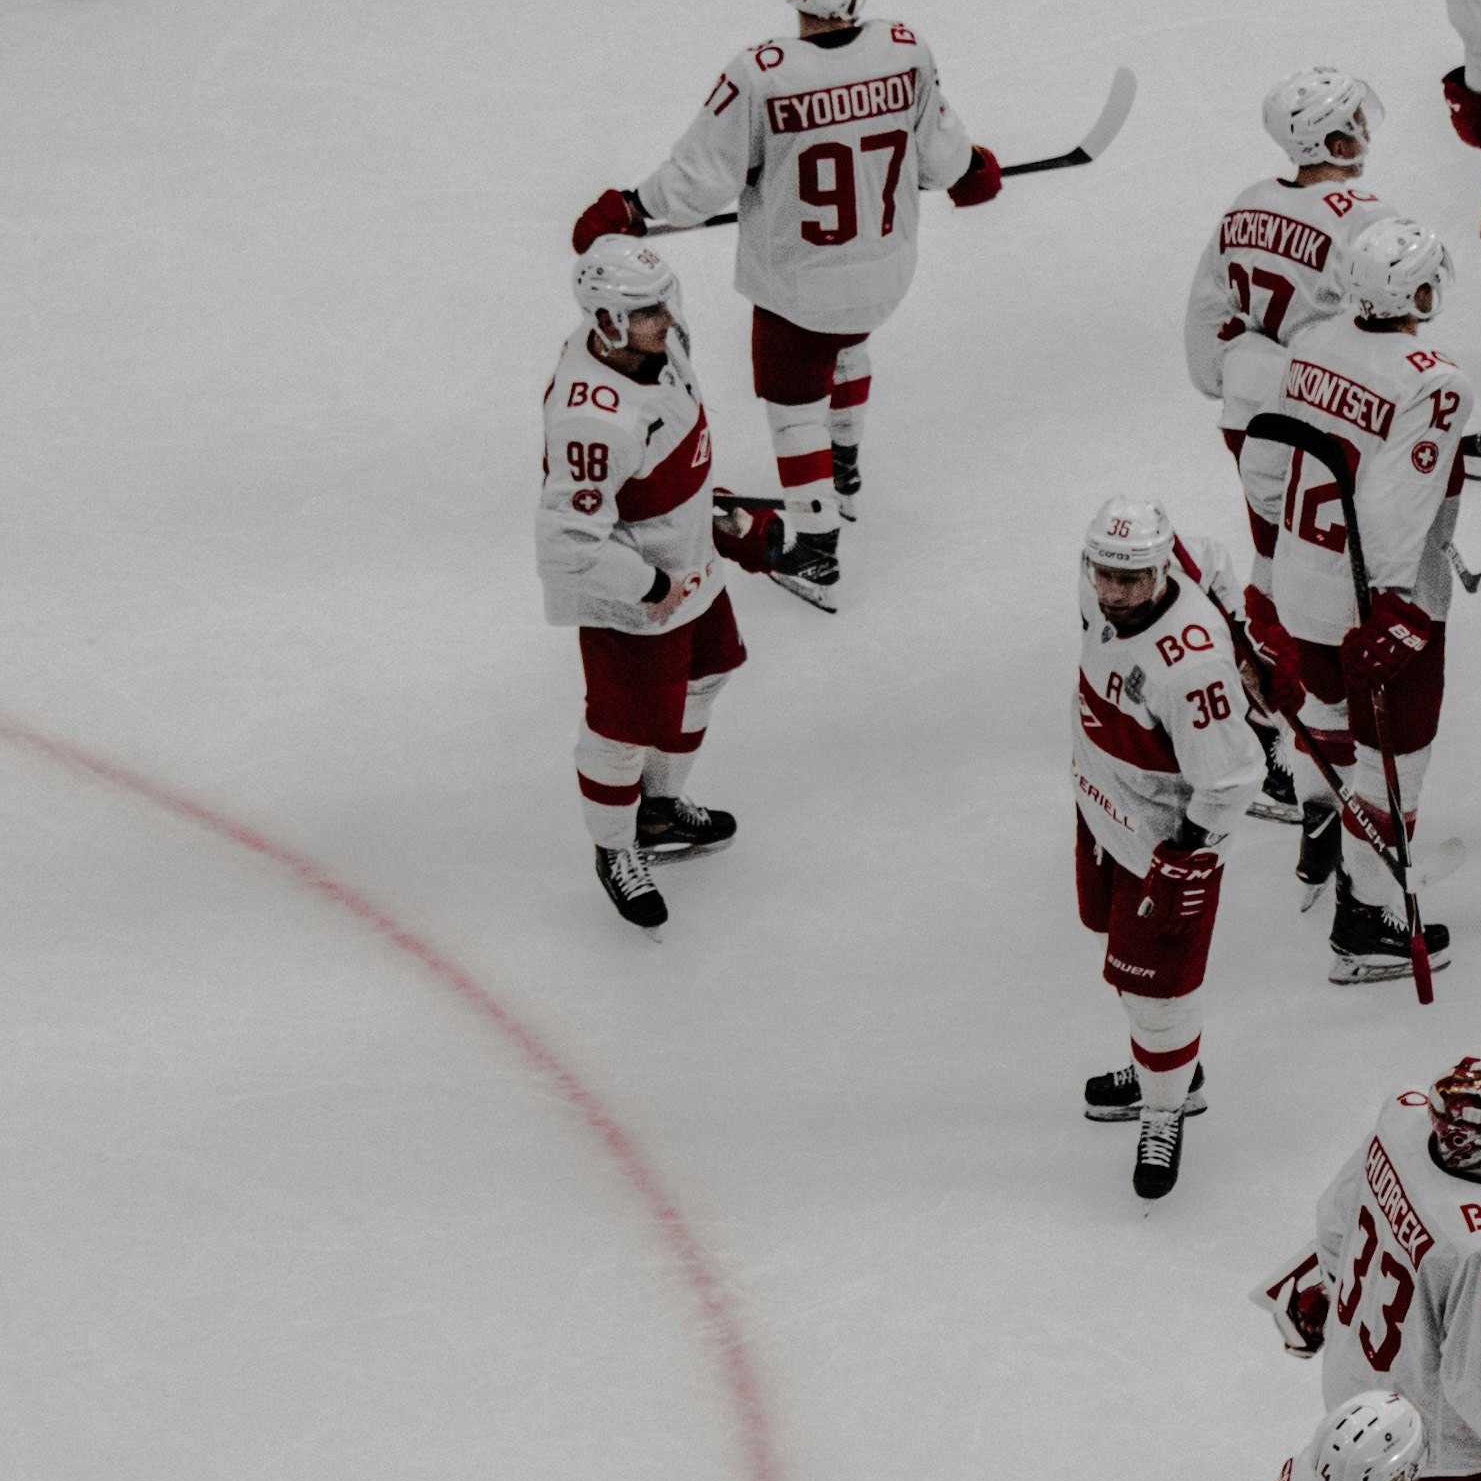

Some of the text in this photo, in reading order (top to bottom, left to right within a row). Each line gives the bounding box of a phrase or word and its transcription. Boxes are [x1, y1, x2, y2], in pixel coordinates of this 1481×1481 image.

[797, 129, 909, 246] 97
[566, 381, 620, 414] BQ
[1427, 388, 1462, 433] 12
[566, 440, 610, 483] 98
[1107, 517, 1133, 539] 36
[1155, 623, 1215, 668] BQ
[1106, 670, 1124, 706] A
[1186, 679, 1232, 730] 36
[1336, 1204, 1416, 1373] 33
